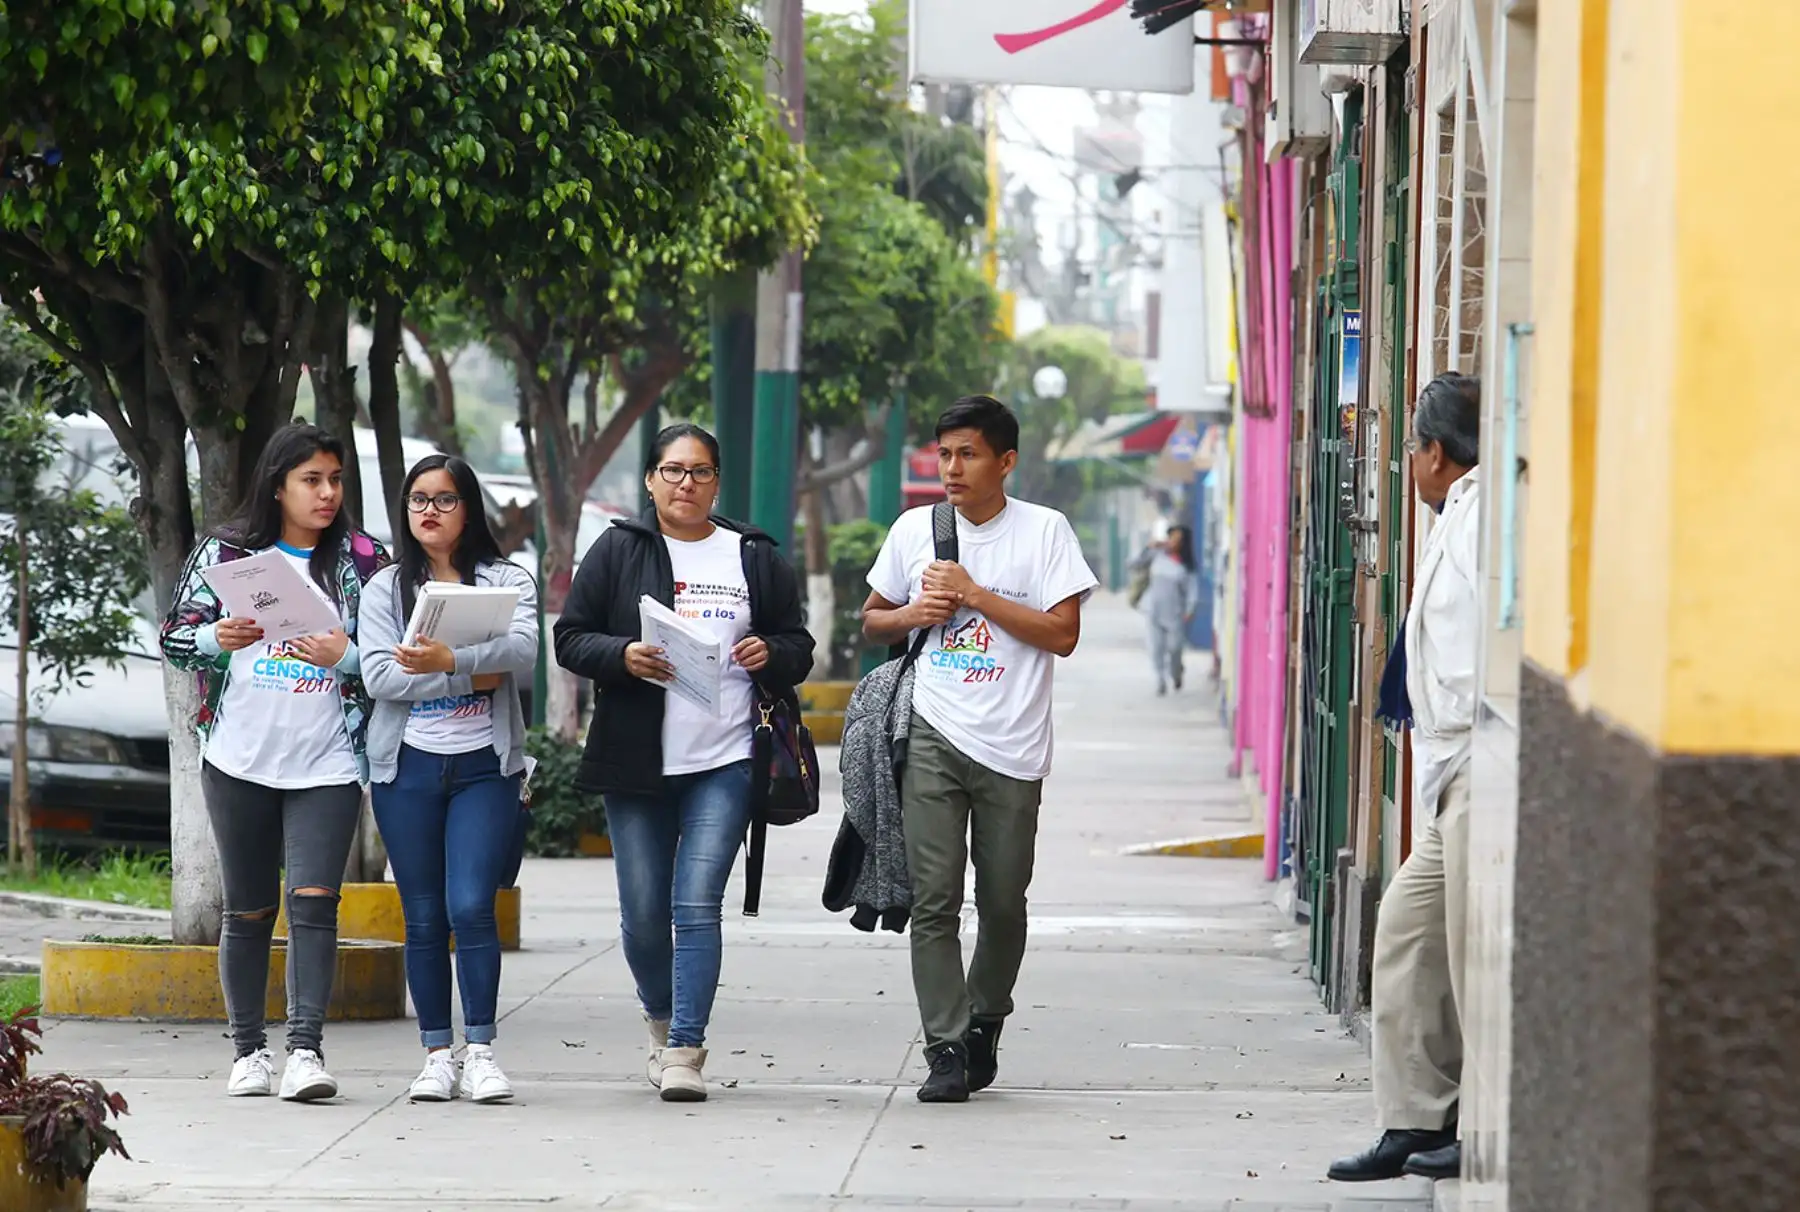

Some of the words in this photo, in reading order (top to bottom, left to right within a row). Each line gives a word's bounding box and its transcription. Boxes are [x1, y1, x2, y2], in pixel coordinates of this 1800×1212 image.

[703, 609, 712, 618] a
[715, 607, 736, 620] los
[253, 658, 327, 681] CENSOS
[929, 650, 996, 671] CENSOS
[962, 666, 1005, 683] 2017
[293, 676, 334, 694] 2017
